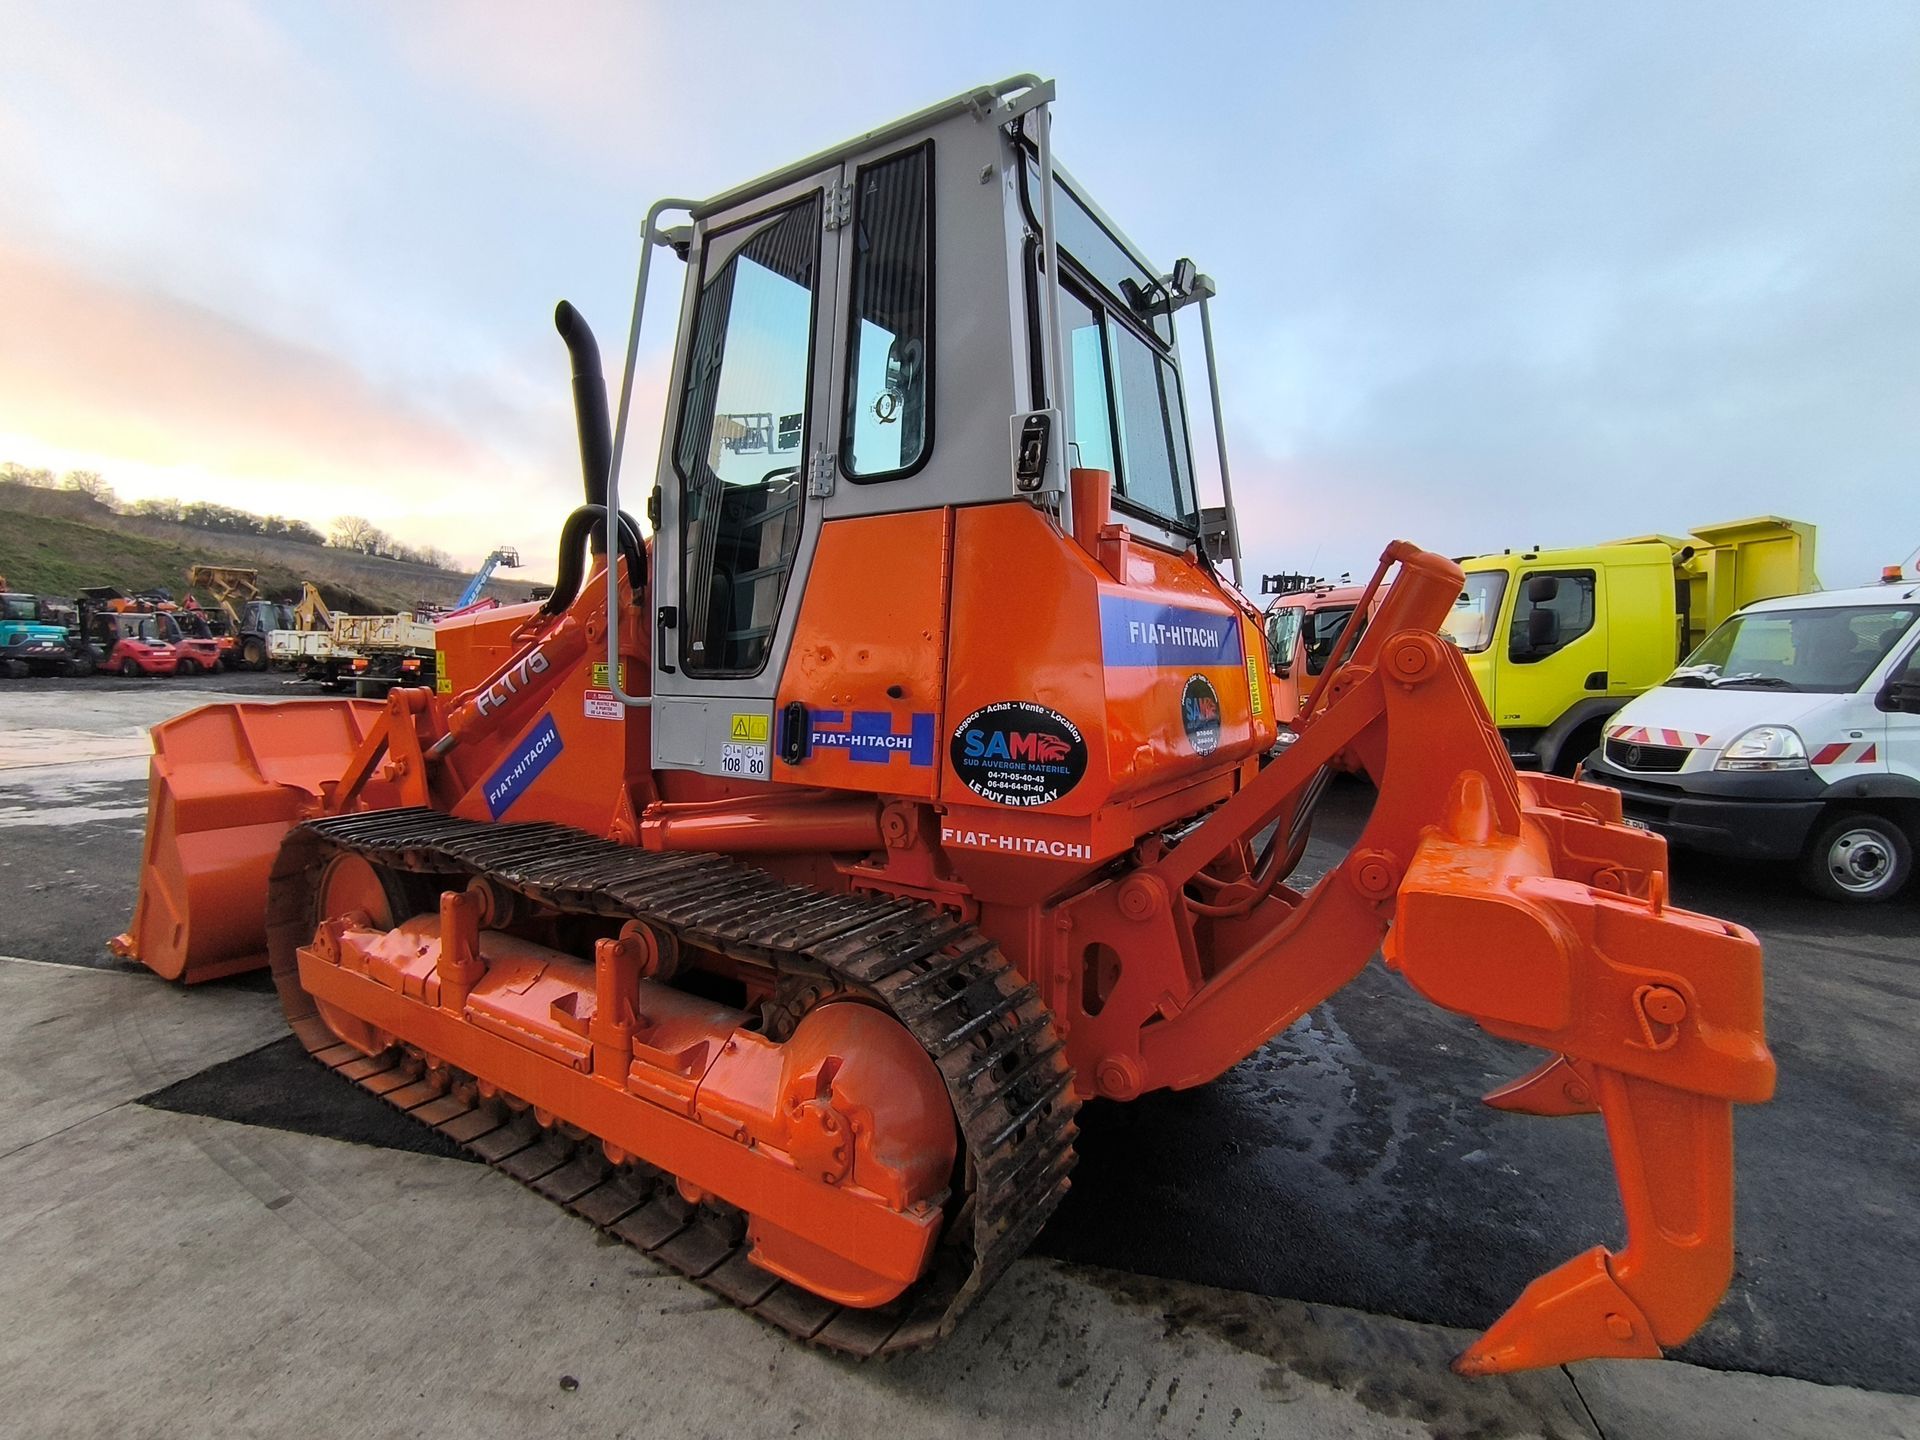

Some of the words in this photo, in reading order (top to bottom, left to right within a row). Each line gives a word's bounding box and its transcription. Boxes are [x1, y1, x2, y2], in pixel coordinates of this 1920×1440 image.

[1129, 622, 1218, 648] FIAT-HITACHI
[987, 702, 1011, 714] Achat
[1019, 702, 1044, 714] Vente
[1050, 710, 1082, 743] Location
[812, 733, 912, 749] FIAT-HITACHI
[964, 729, 1038, 761] SAM
[490, 729, 556, 805] FIAT-HITACHI
[722, 758, 740, 772] 108
[750, 759, 763, 773] 80
[963, 758, 979, 767] SUD
[981, 760, 1026, 771] AUVERGNE
[1028, 763, 1070, 775] MATERIEL
[987, 781, 1044, 793] 06-84-64-81-40
[988, 771, 1045, 783] 04-71-05-40-43
[968, 779, 982, 794] LE
[982, 789, 1003, 803] PUY
[1005, 795, 1021, 806] EN
[1022, 788, 1059, 806] VELAY
[941, 829, 1091, 859] FIAT-HITACHI
